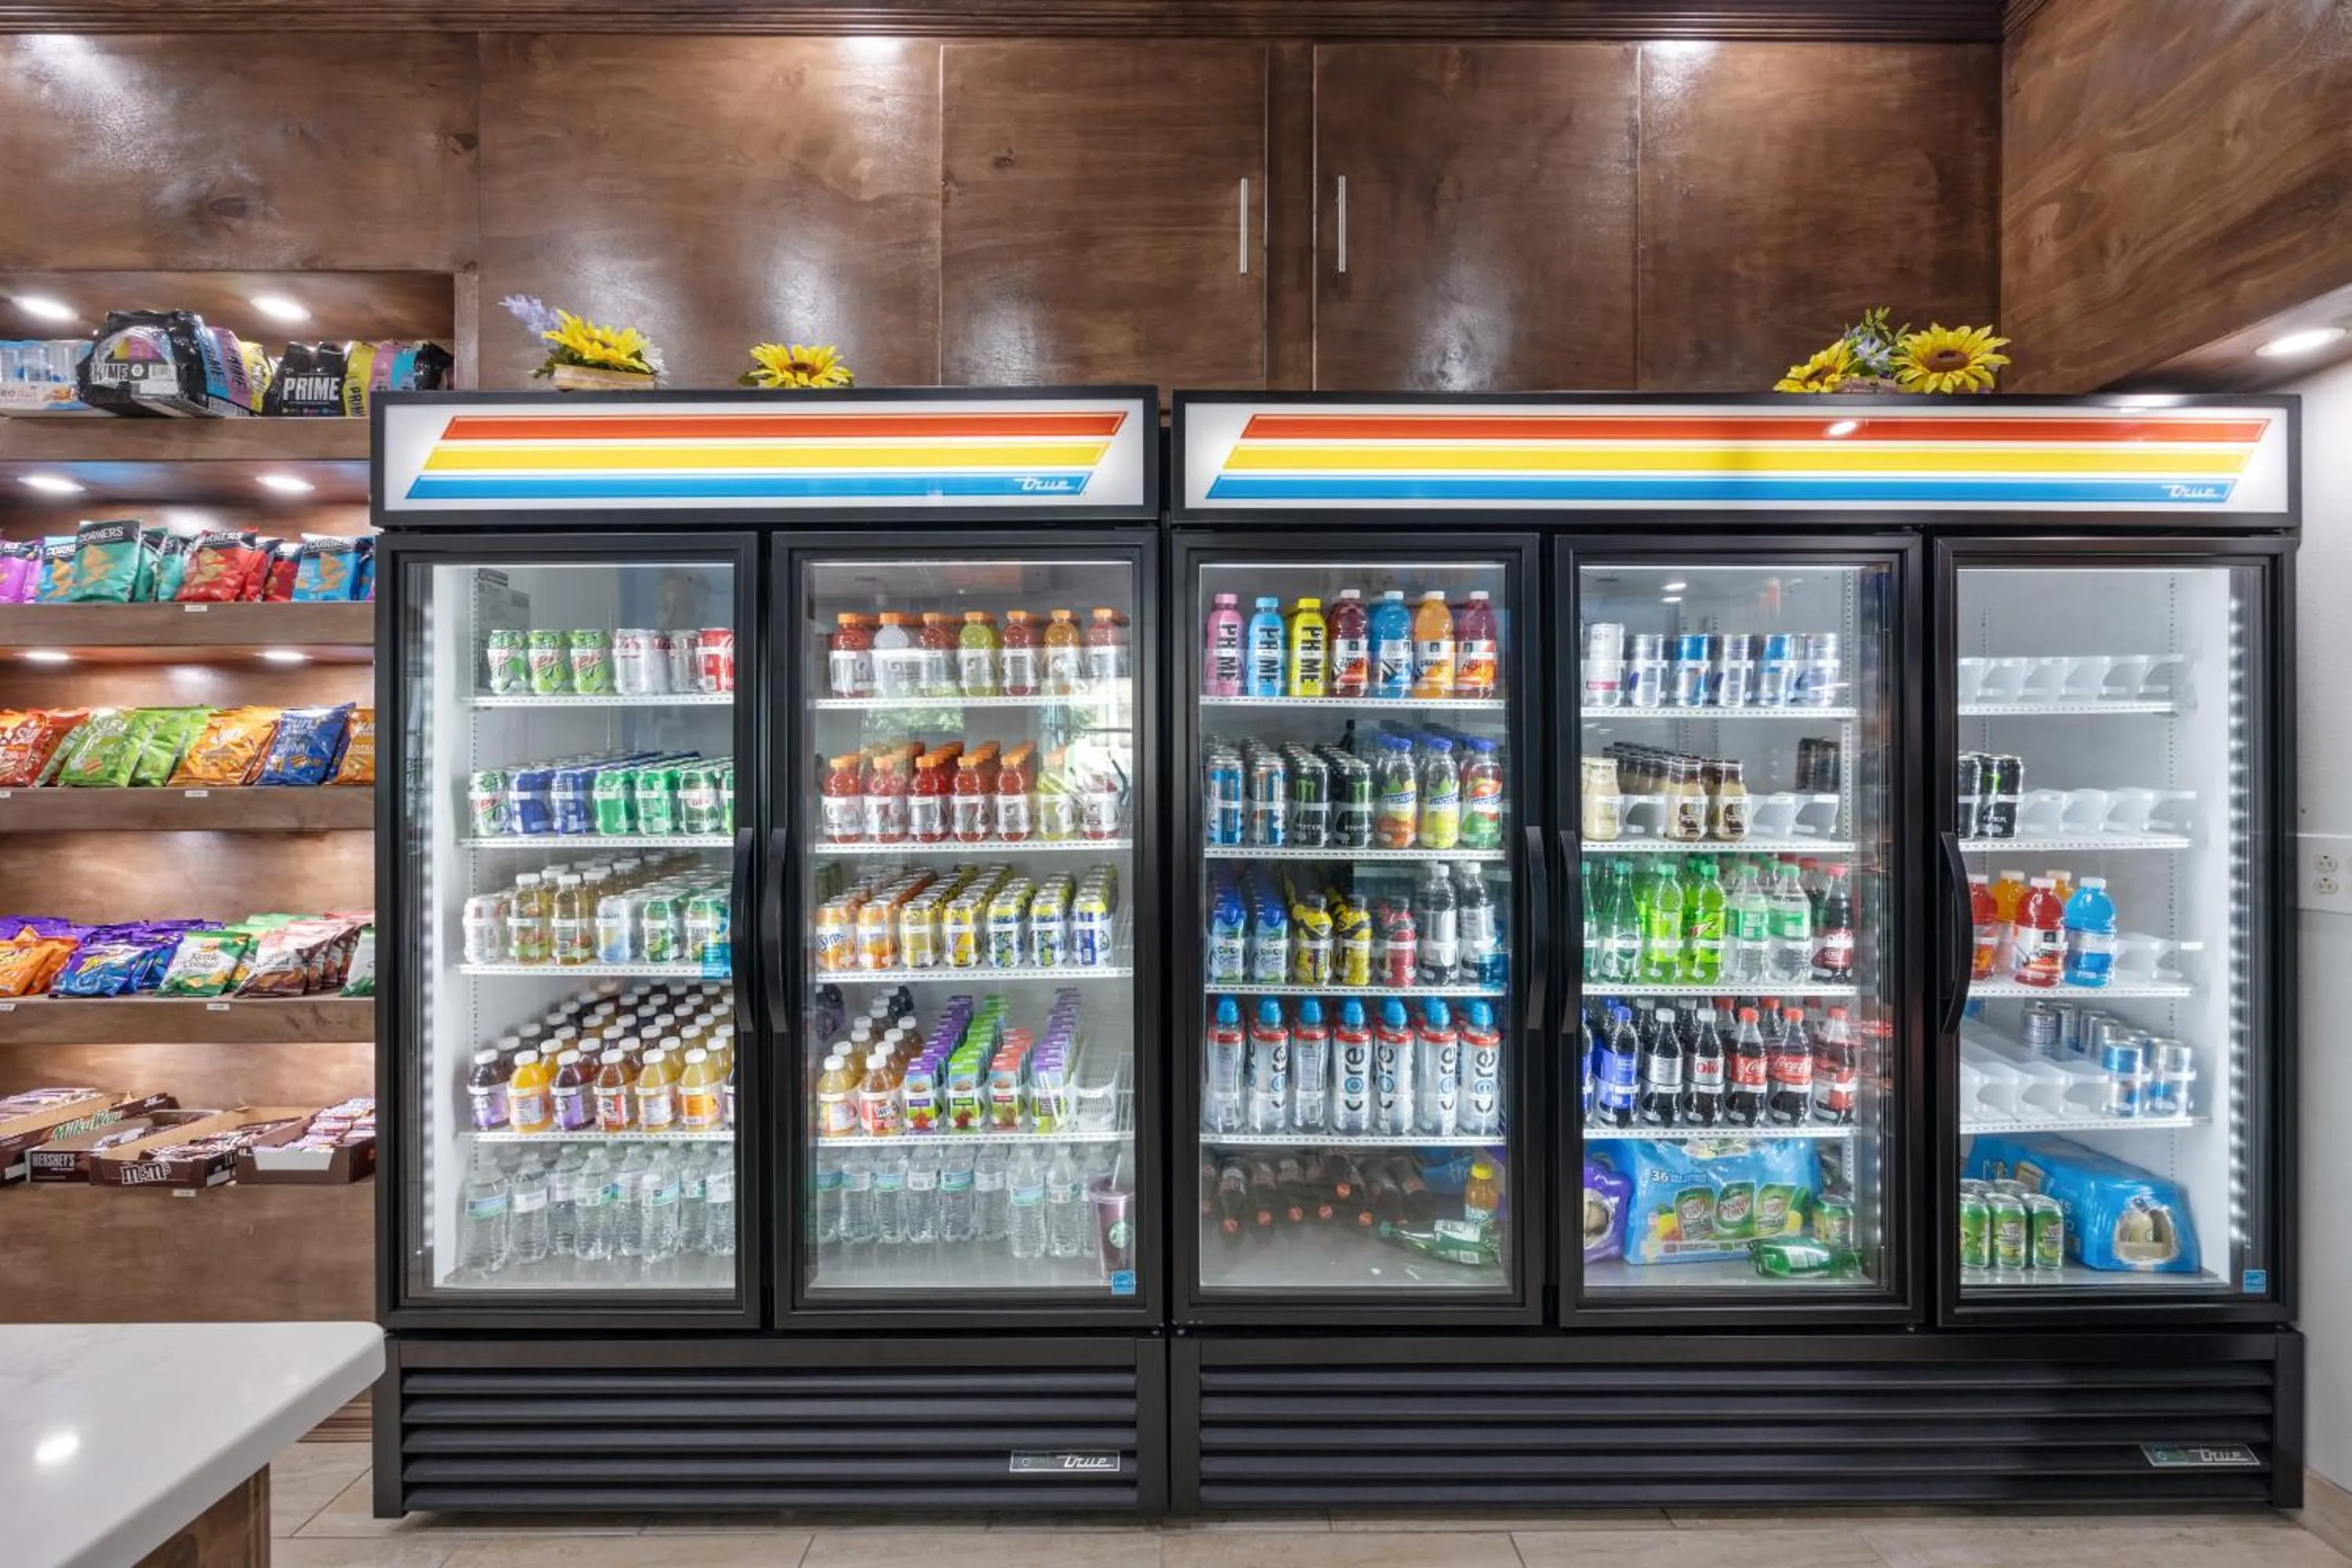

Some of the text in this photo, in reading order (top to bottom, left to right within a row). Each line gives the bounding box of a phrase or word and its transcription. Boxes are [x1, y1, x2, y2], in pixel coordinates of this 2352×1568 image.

[283, 377, 340, 401] PRIME
[1014, 477, 1072, 490] True
[2161, 484, 2219, 498] True
[1345, 1047, 1364, 1111] core
[1377, 1045, 1394, 1109] core
[1441, 1047, 1455, 1110] core
[1475, 1051, 1495, 1113] core
[32, 1153, 75, 1167] HERSHEY'S
[1057, 1454, 1114, 1468] True
[2190, 1449, 2249, 1461] True
